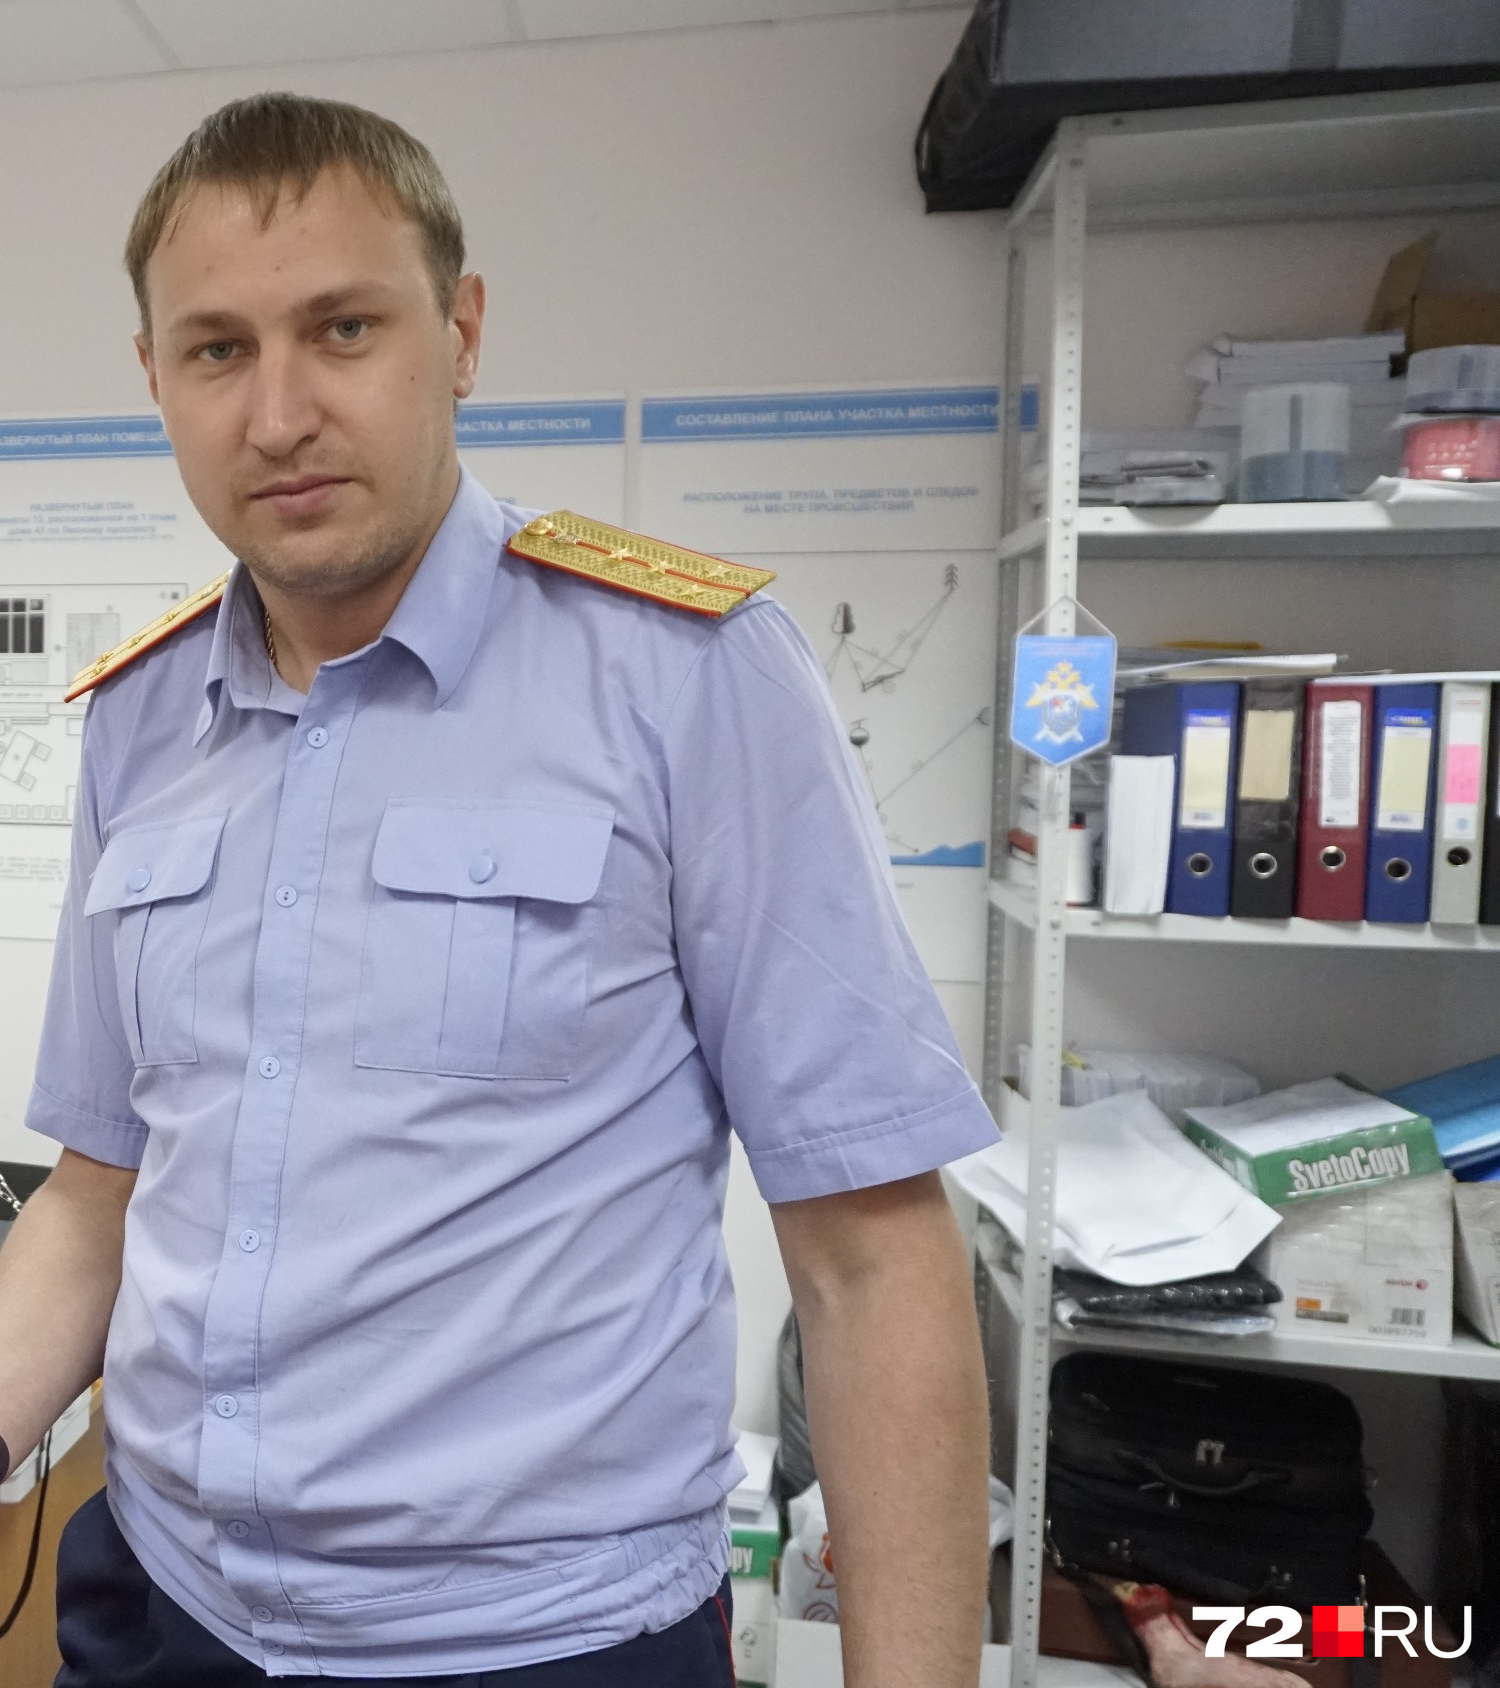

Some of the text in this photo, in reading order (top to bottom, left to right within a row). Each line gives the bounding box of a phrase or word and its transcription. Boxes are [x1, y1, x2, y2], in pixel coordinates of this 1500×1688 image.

[507, 416, 591, 431] МЕСТНОСТИ
[676, 411, 779, 427] СОСТАВЛЕНИЕ
[784, 408, 834, 423] ПЛАНА
[837, 405, 904, 421] УЧАСТКА
[75, 433, 109, 445] ПЛАН
[683, 491, 783, 502] РАСПОЛОЖЕНИЕ
[834, 488, 910, 499] ПРЕДМЕТОВ
[927, 485, 978, 498] СЛЕДОВ
[106, 501, 134, 511] ПЛАН
[744, 503, 761, 513] НА
[764, 502, 804, 513] МЕСТЕ
[1289, 1143, 1410, 1190] SvetoCopy
